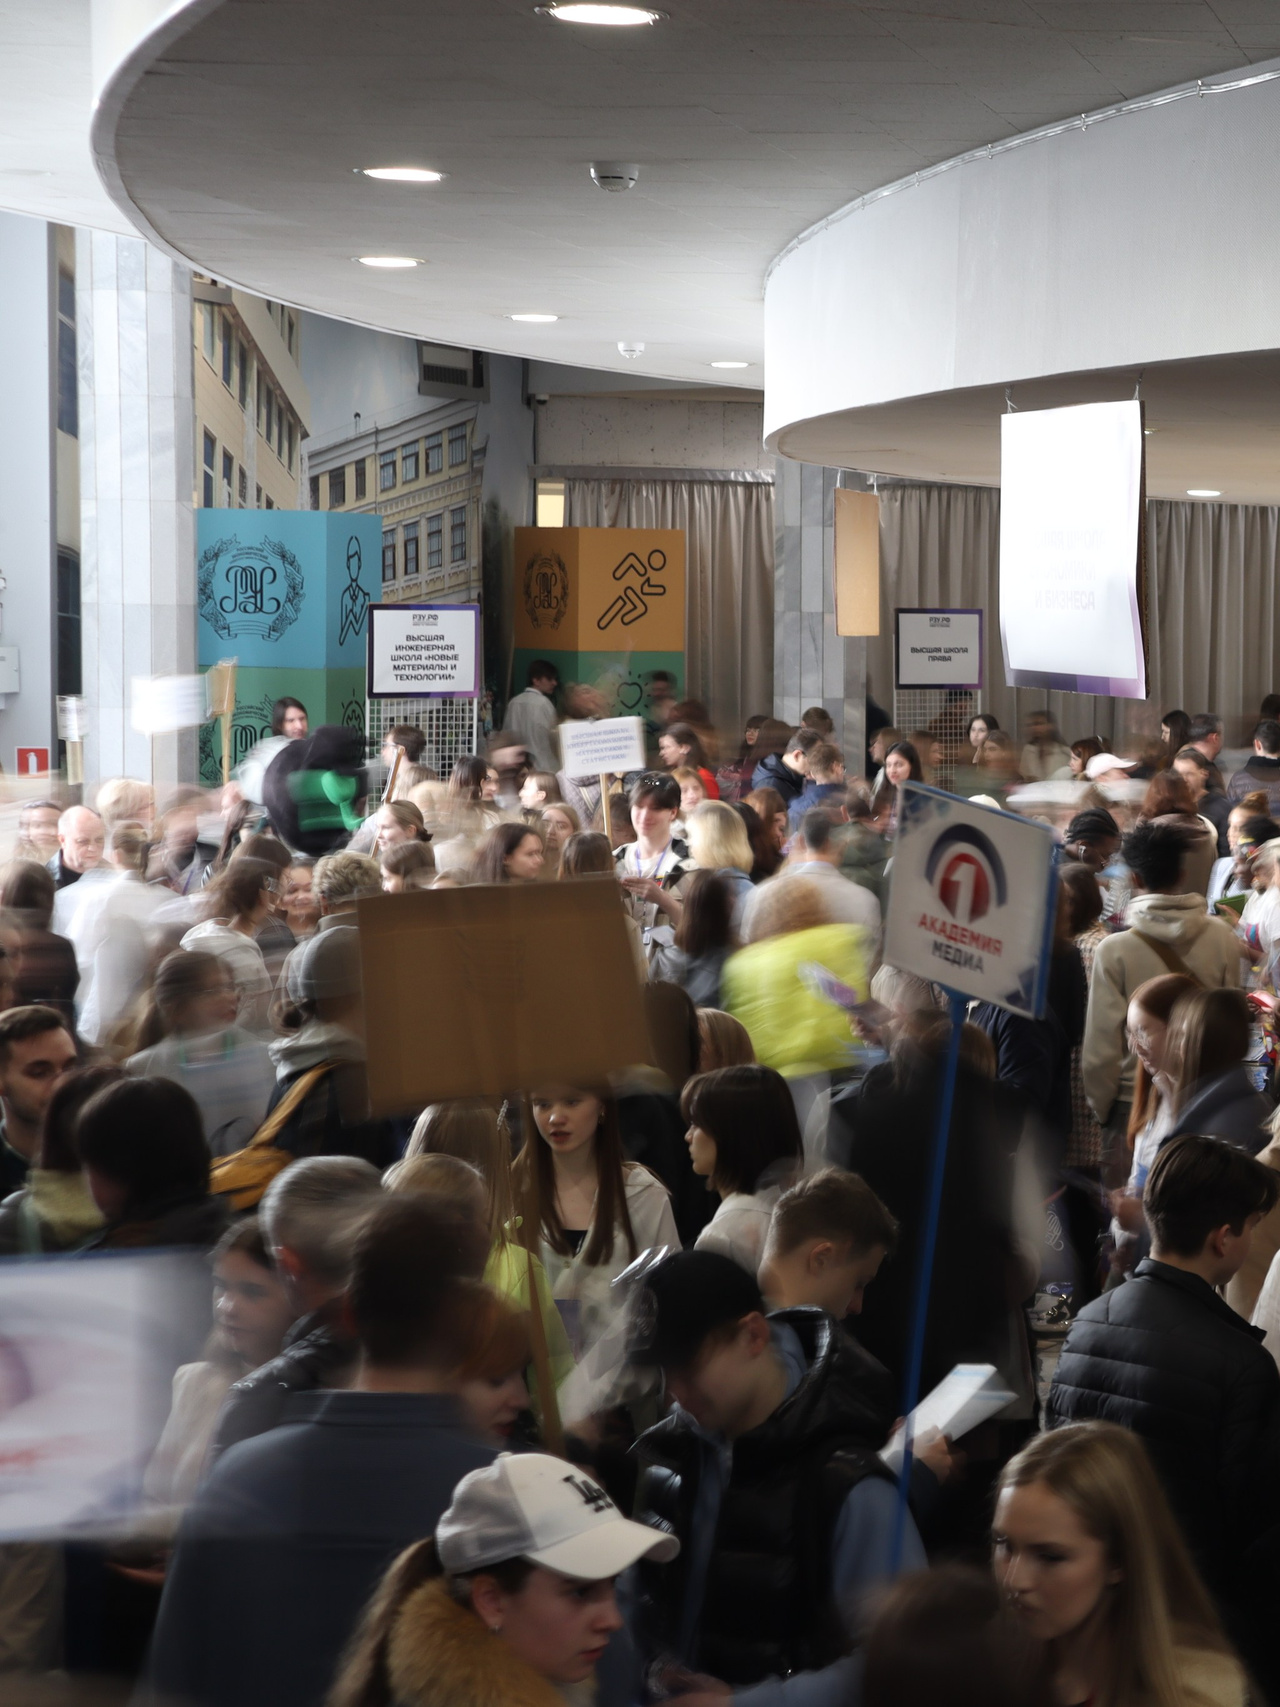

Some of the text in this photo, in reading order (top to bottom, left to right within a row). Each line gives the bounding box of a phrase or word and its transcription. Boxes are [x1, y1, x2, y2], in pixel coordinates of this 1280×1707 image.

[1045, 590, 1095, 610] БИЗНЕСА
[406, 634, 445, 642] ВЫСШАЯ
[395, 644, 455, 652] ИНЖЕНЕРНАЯ
[390, 653, 459, 662] ШКОЛА «НОВЫЕ
[392, 663, 457, 671] МАТЕРИАЛЫ И
[394, 673, 455, 681] ТЕХНОЛОГИИ»
[918, 913, 1003, 957] АКАДЕМИЯ
[932, 940, 984, 974] МЕДИА
